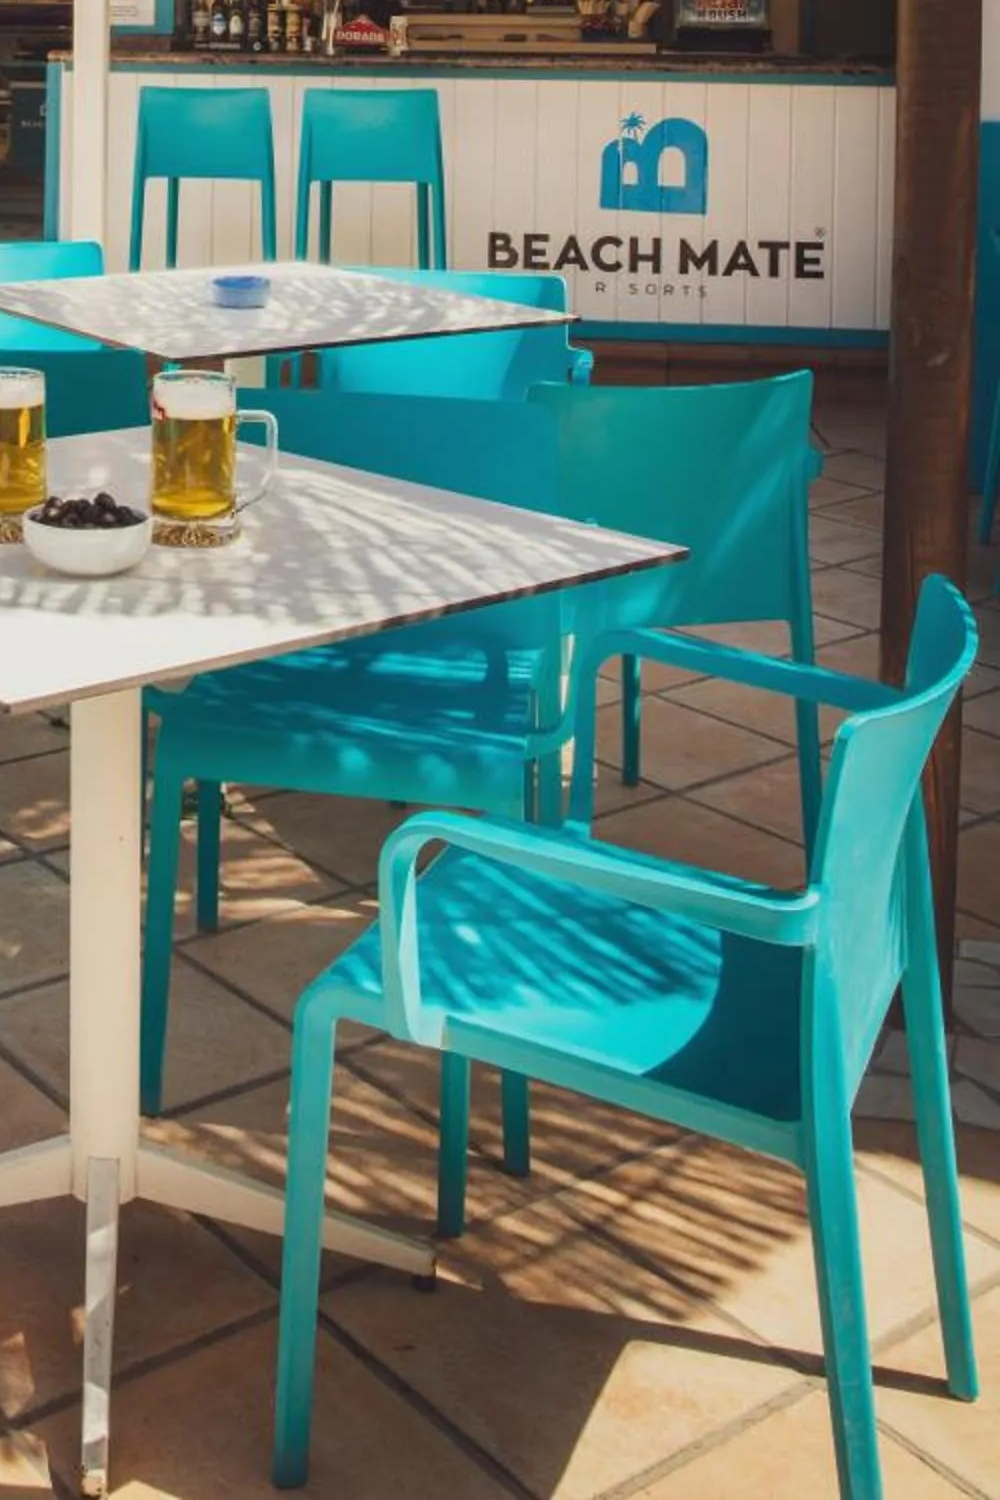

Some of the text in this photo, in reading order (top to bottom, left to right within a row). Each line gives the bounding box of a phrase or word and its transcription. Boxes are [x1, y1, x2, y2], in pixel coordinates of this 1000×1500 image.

[487, 231, 826, 280] BEACH MATE
[595, 281, 708, 299] RSORTS
